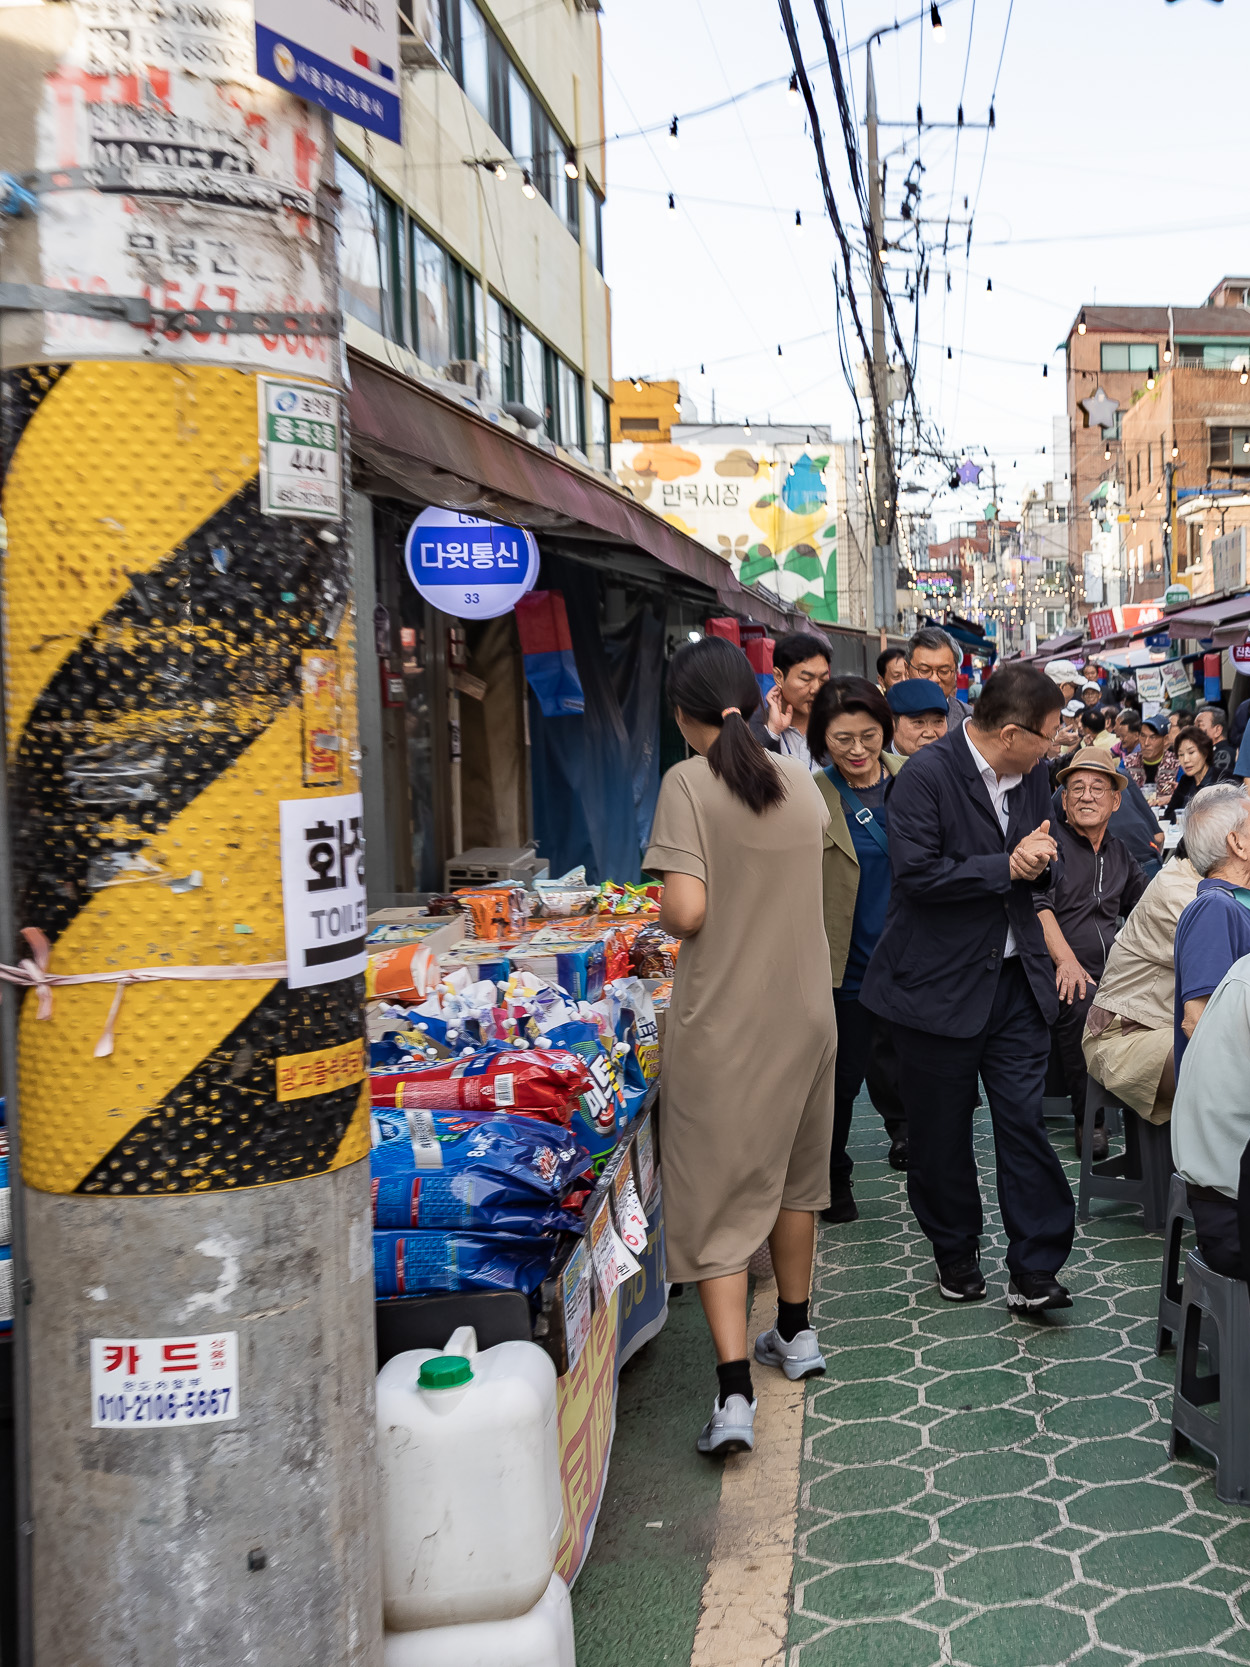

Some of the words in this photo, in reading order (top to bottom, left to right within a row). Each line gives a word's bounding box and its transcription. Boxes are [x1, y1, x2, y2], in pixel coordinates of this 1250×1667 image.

[662, 483, 740, 507] 면곡시장
[420, 541, 519, 569] 다윗통신
[464, 593, 480, 604] 33
[309, 899, 365, 939] TOILE
[98, 1386, 232, 1421] 010-2106-5667
